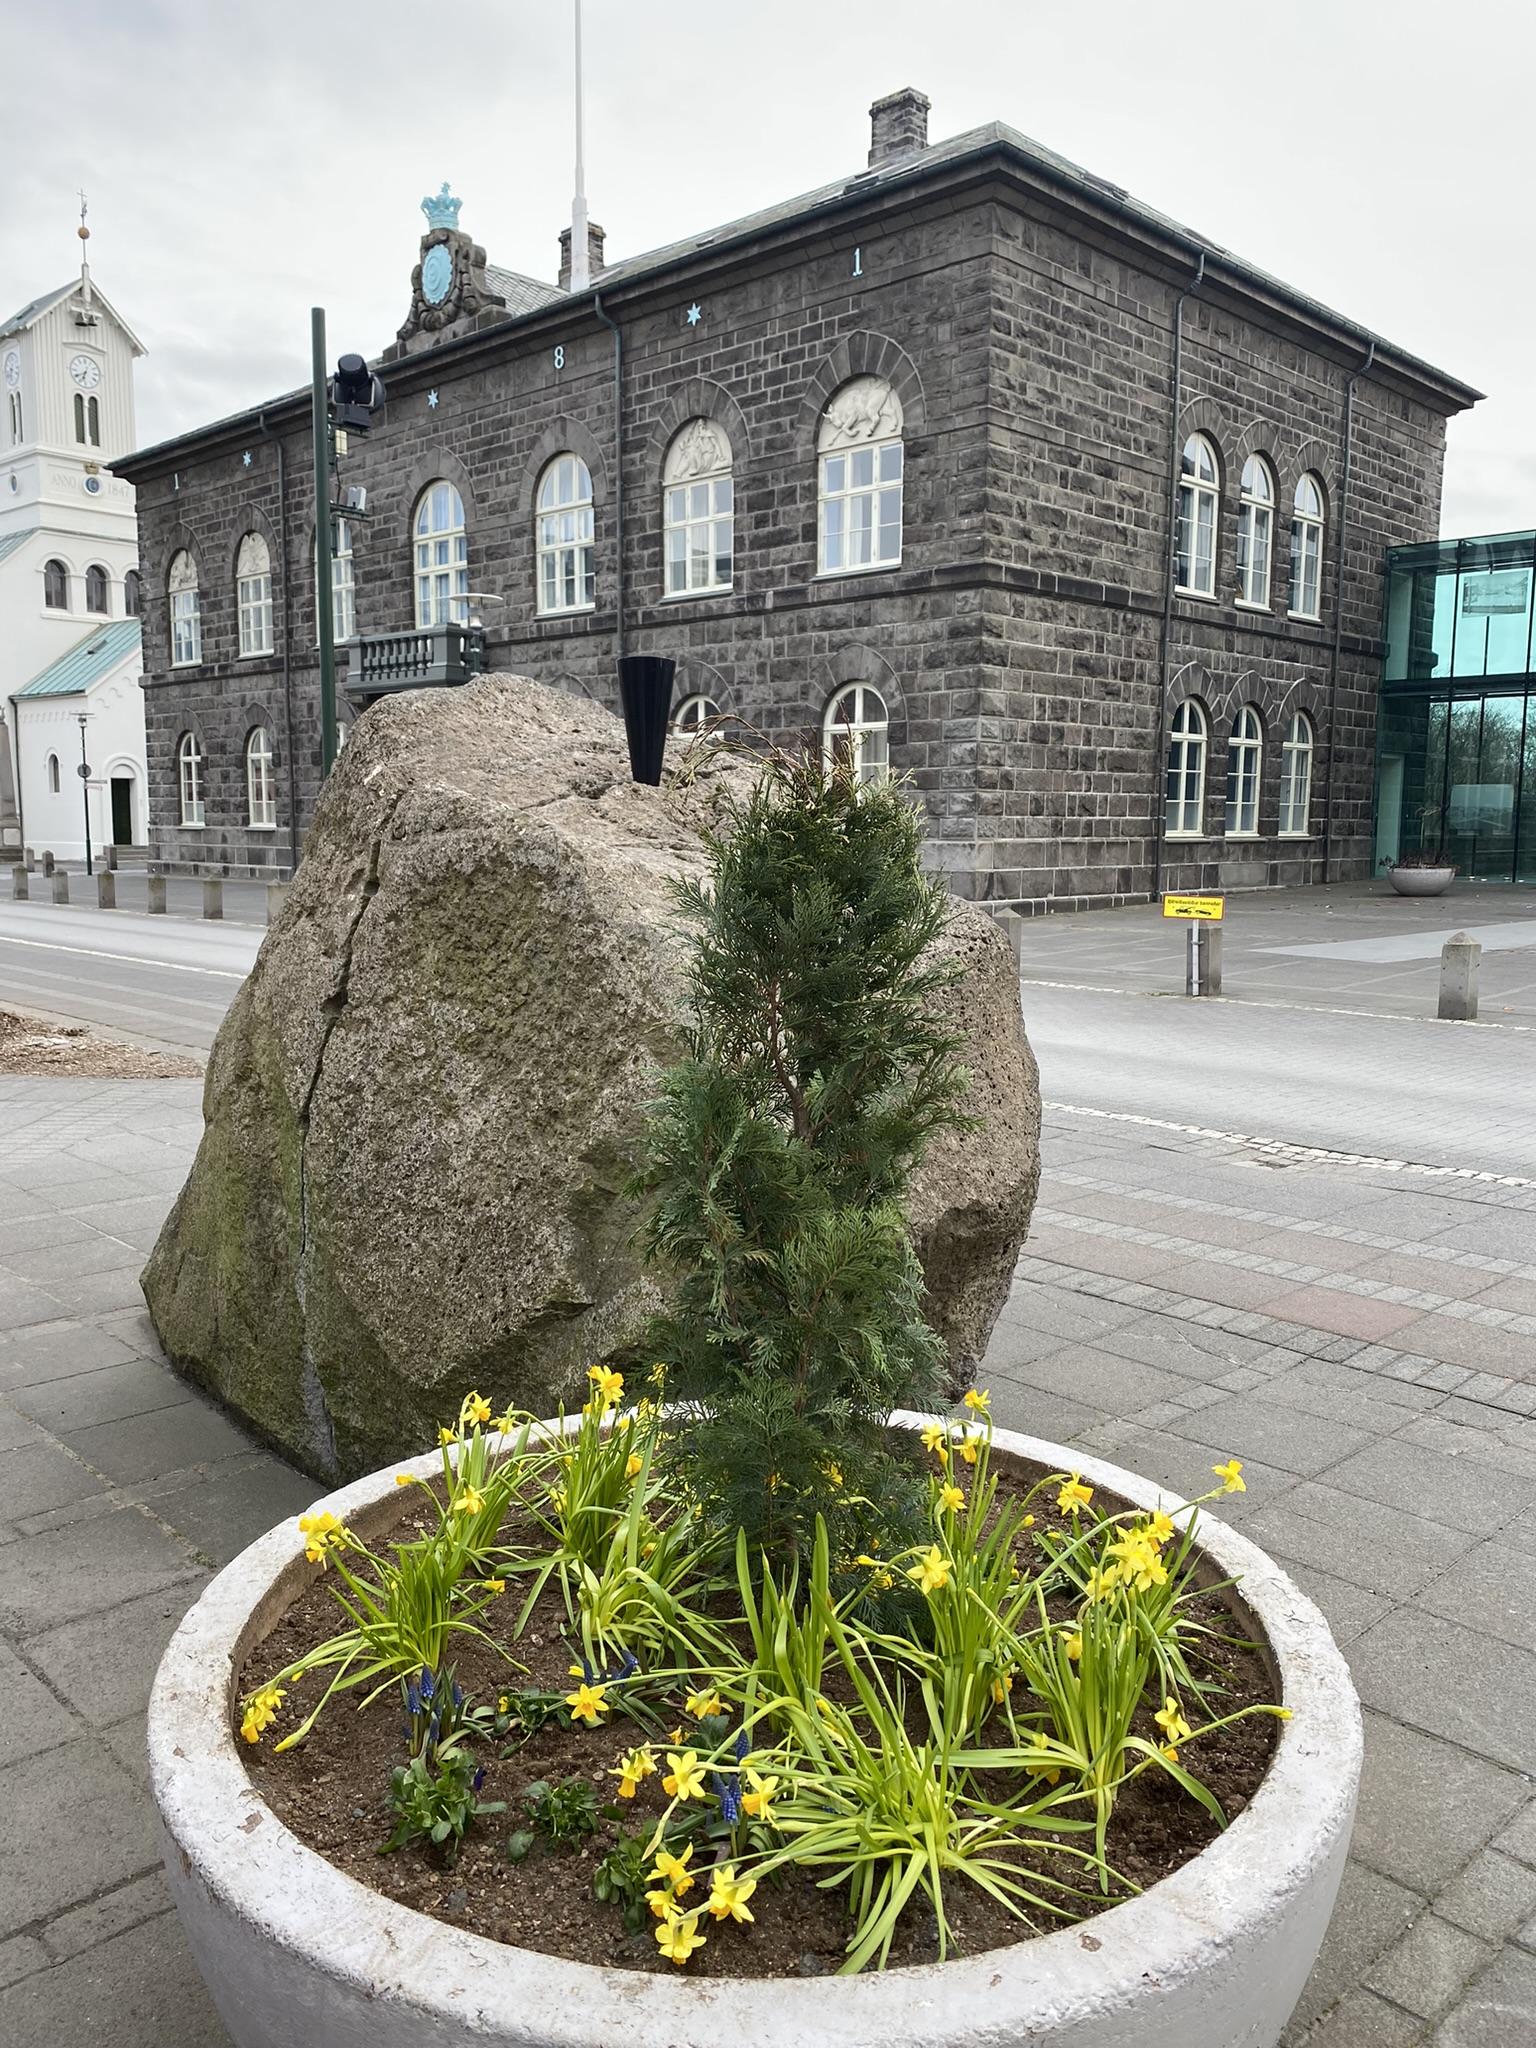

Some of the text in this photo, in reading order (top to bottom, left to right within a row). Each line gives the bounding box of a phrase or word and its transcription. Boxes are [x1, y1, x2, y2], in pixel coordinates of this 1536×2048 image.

[554, 345, 564, 369] 8
[852, 247, 863, 277] 1
[108, 482, 130, 496] 1847
